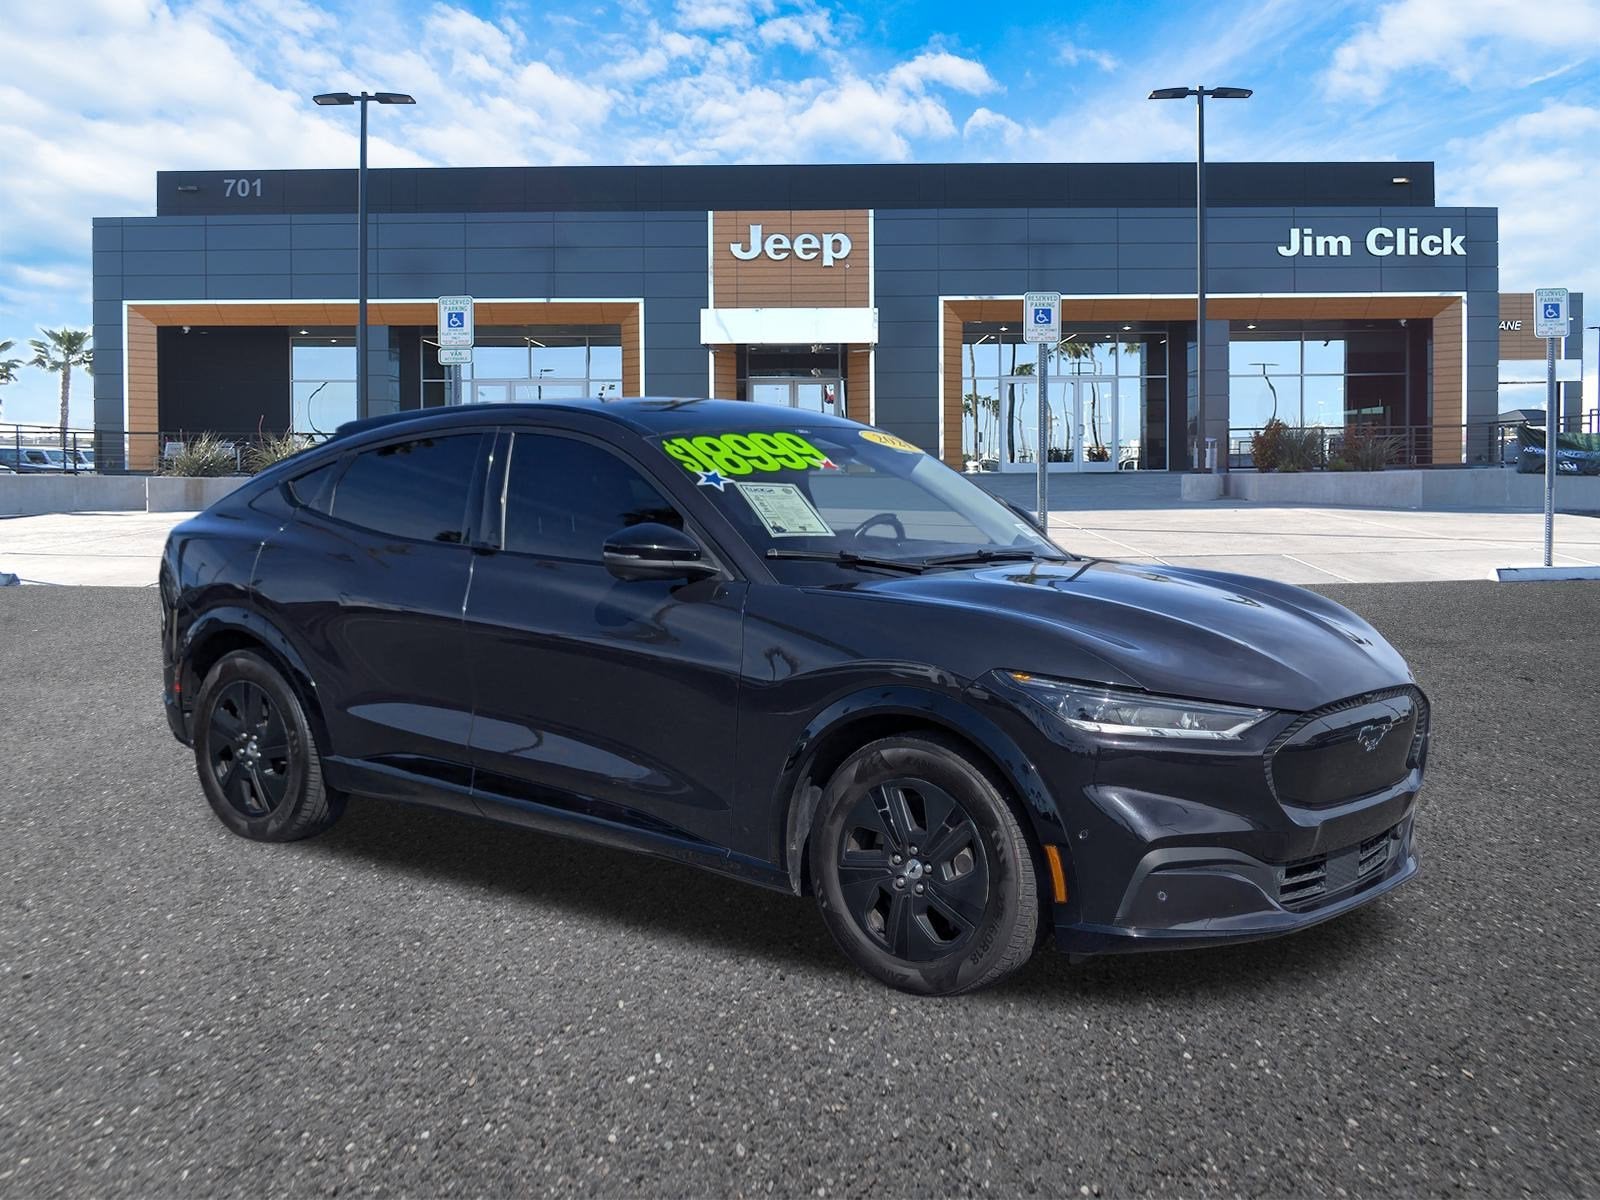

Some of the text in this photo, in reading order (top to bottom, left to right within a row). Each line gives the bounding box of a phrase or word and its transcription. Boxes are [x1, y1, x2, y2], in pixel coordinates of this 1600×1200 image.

[224, 179, 261, 197] 701
[730, 224, 851, 267] Jeep
[1277, 227, 1467, 256] Jim Click
[662, 432, 828, 477] $18999
